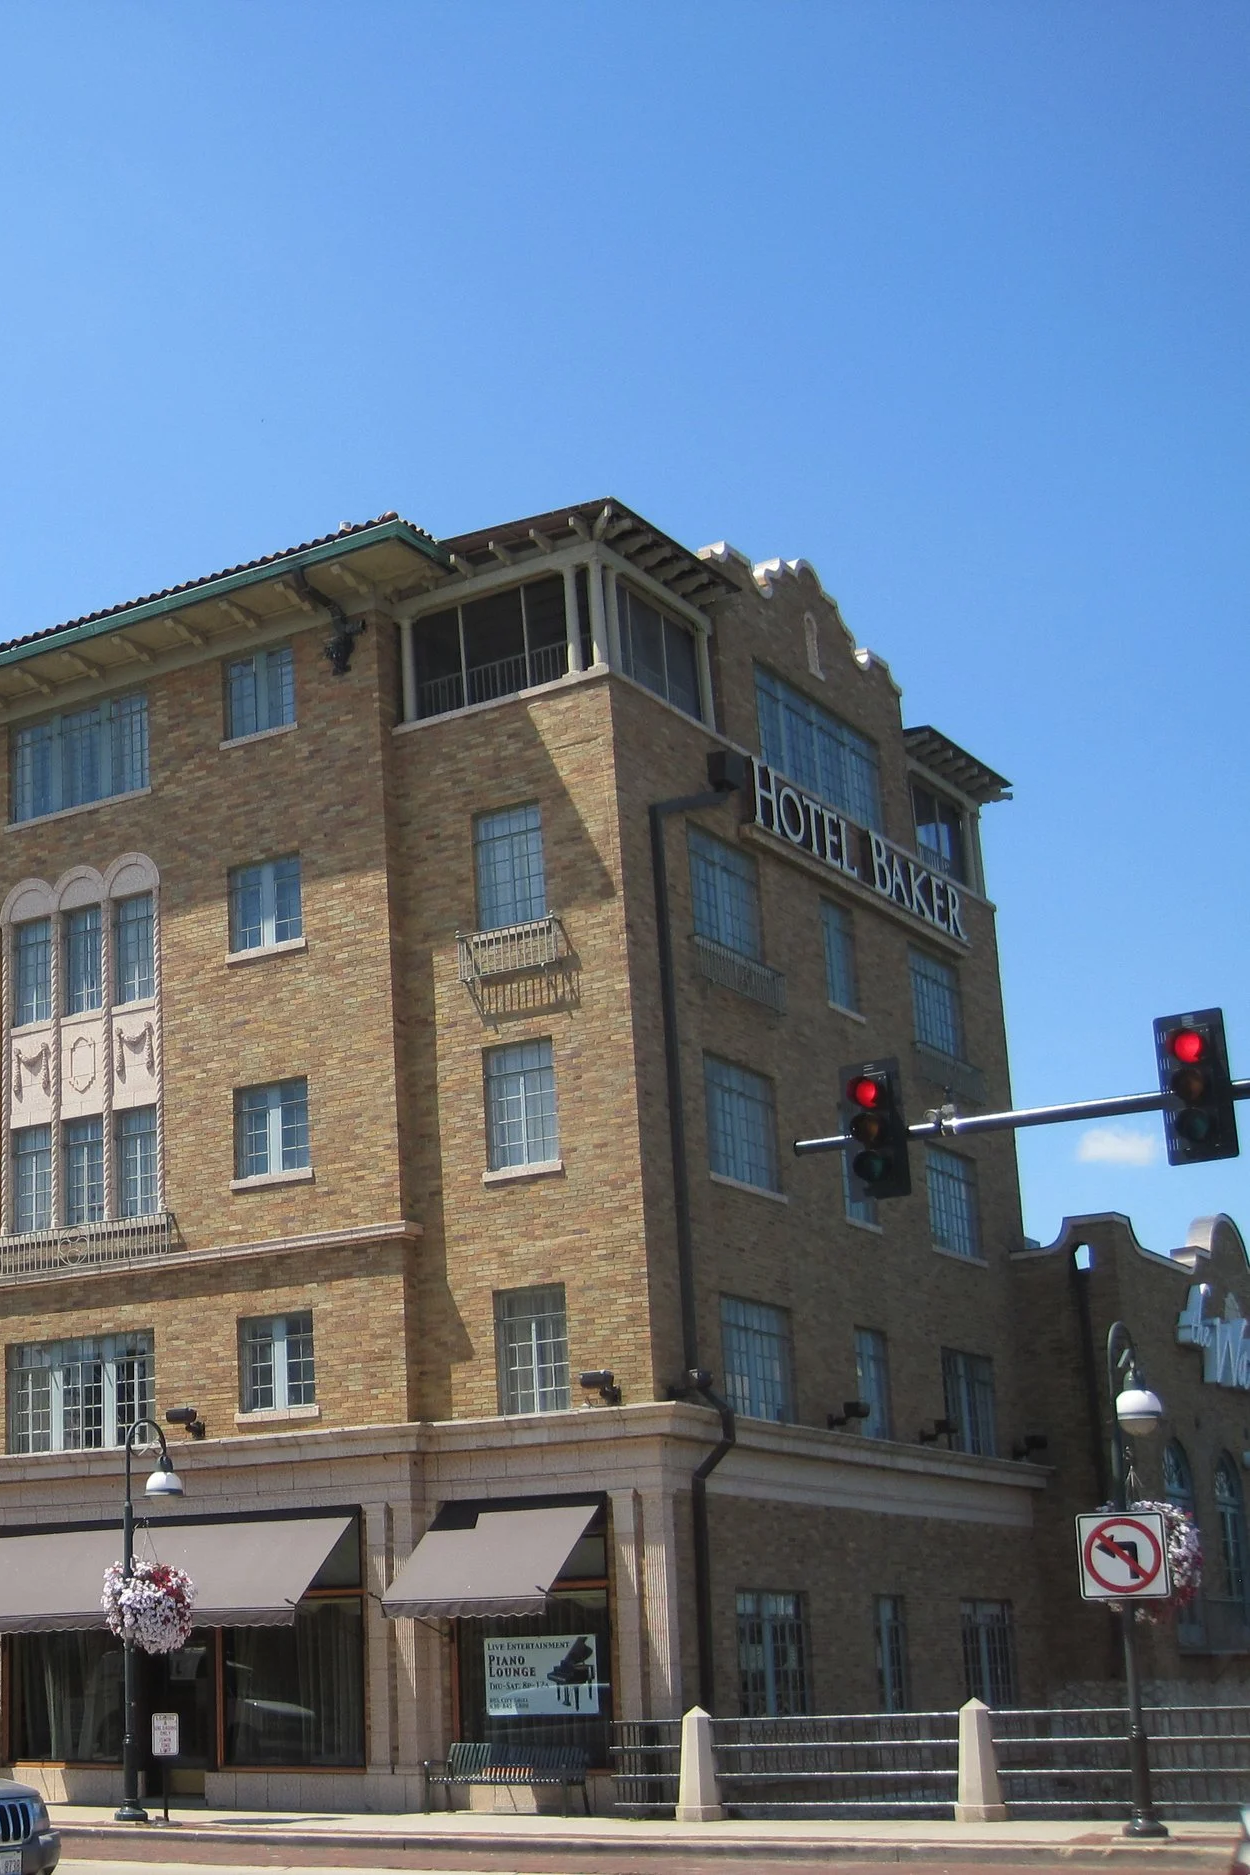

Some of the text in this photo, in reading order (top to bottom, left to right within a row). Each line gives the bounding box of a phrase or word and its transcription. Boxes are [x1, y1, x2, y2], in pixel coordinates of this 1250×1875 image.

[751, 756, 967, 941] HOTEL BAKER
[487, 1641, 570, 1651] LIVE ENTERTAINMENT
[488, 1655, 525, 1666] PIANO
[489, 1667, 536, 1678] LOUNGE
